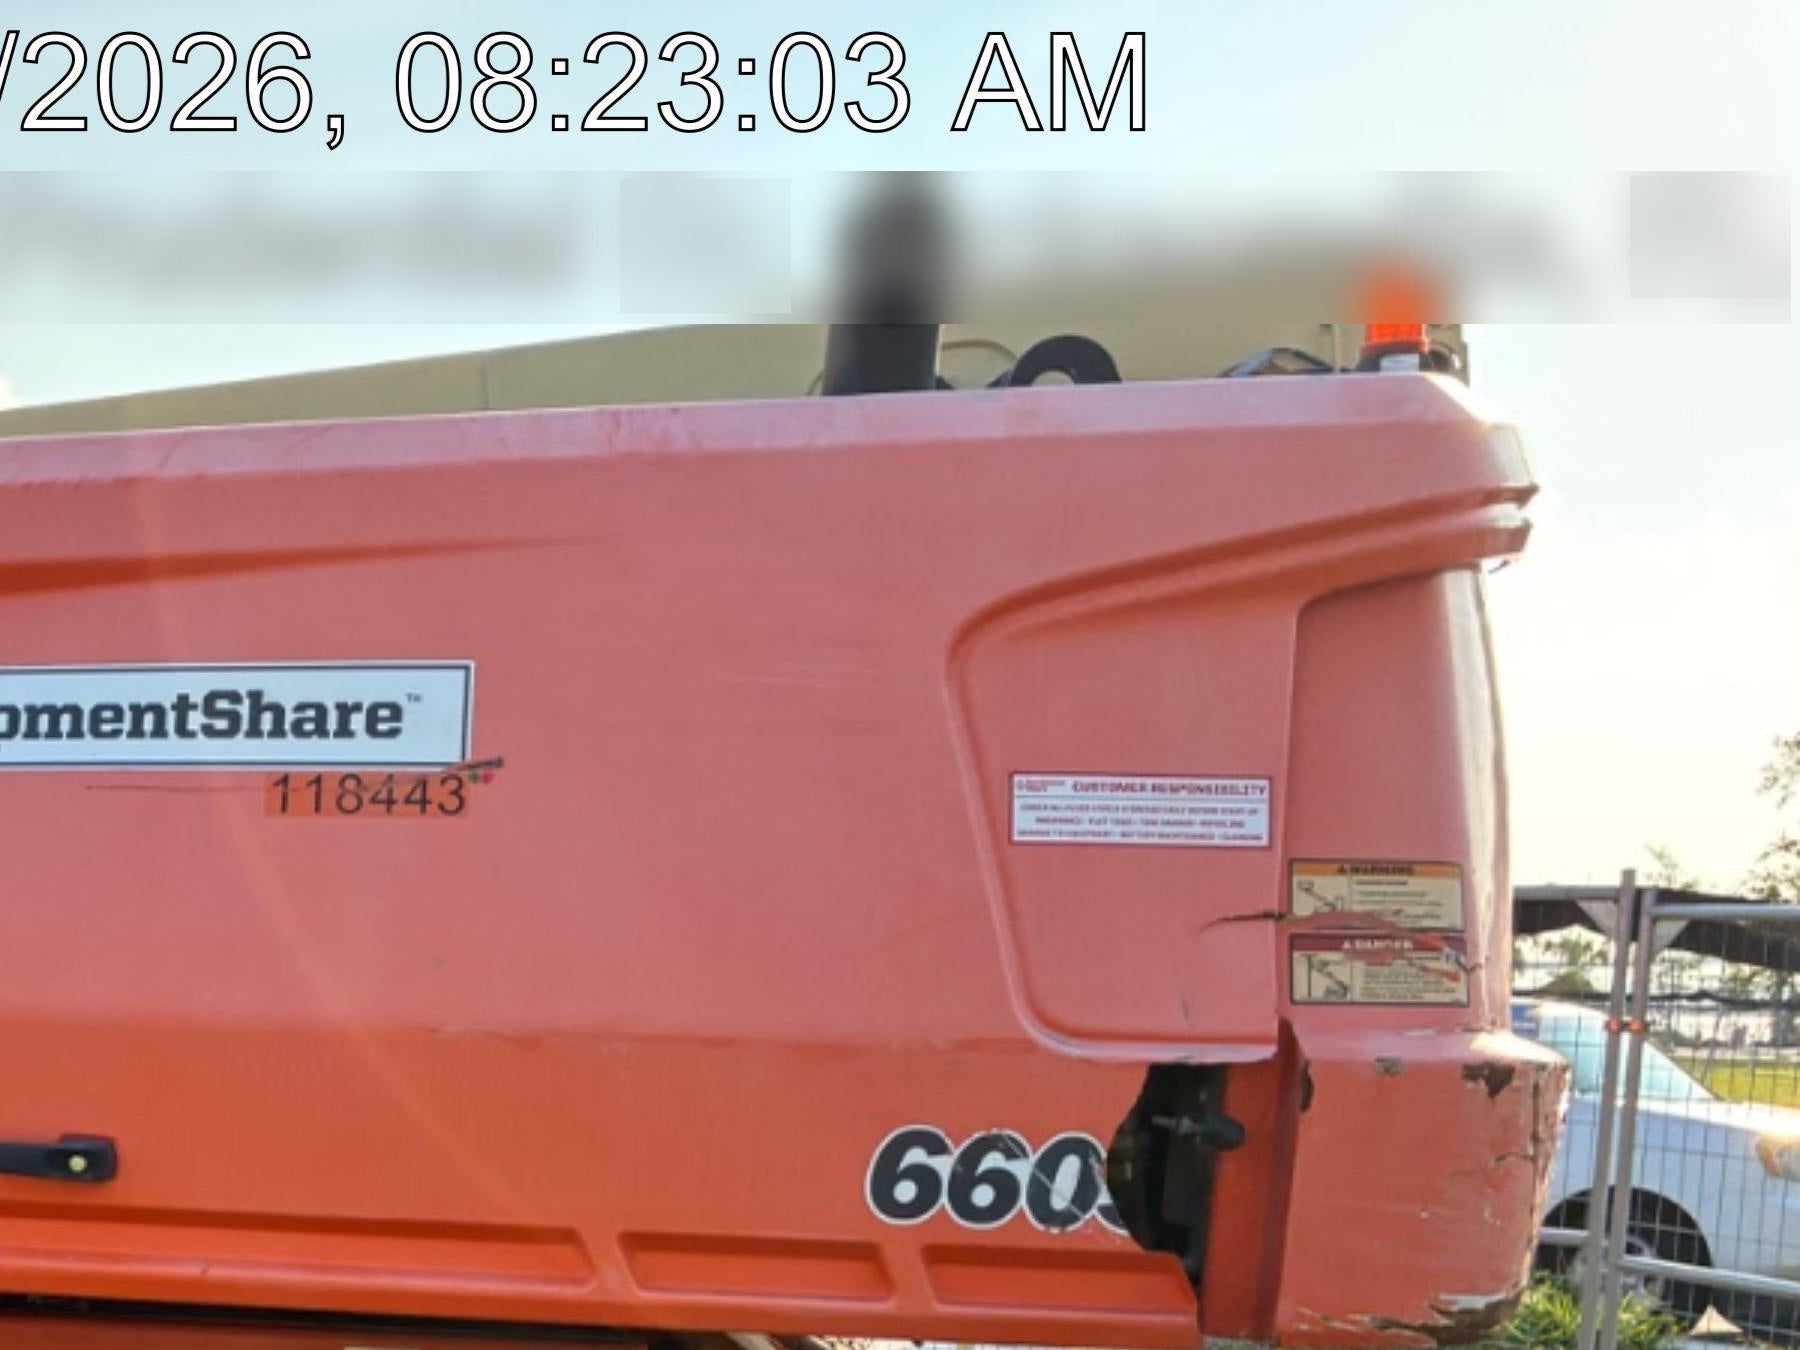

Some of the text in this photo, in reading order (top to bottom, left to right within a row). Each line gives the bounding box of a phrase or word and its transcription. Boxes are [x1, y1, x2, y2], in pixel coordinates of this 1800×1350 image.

[272, 773, 466, 816] 118443
[1072, 782, 1147, 795] CUSTOMER
[1151, 783, 1267, 796] RESPONSIBILITY
